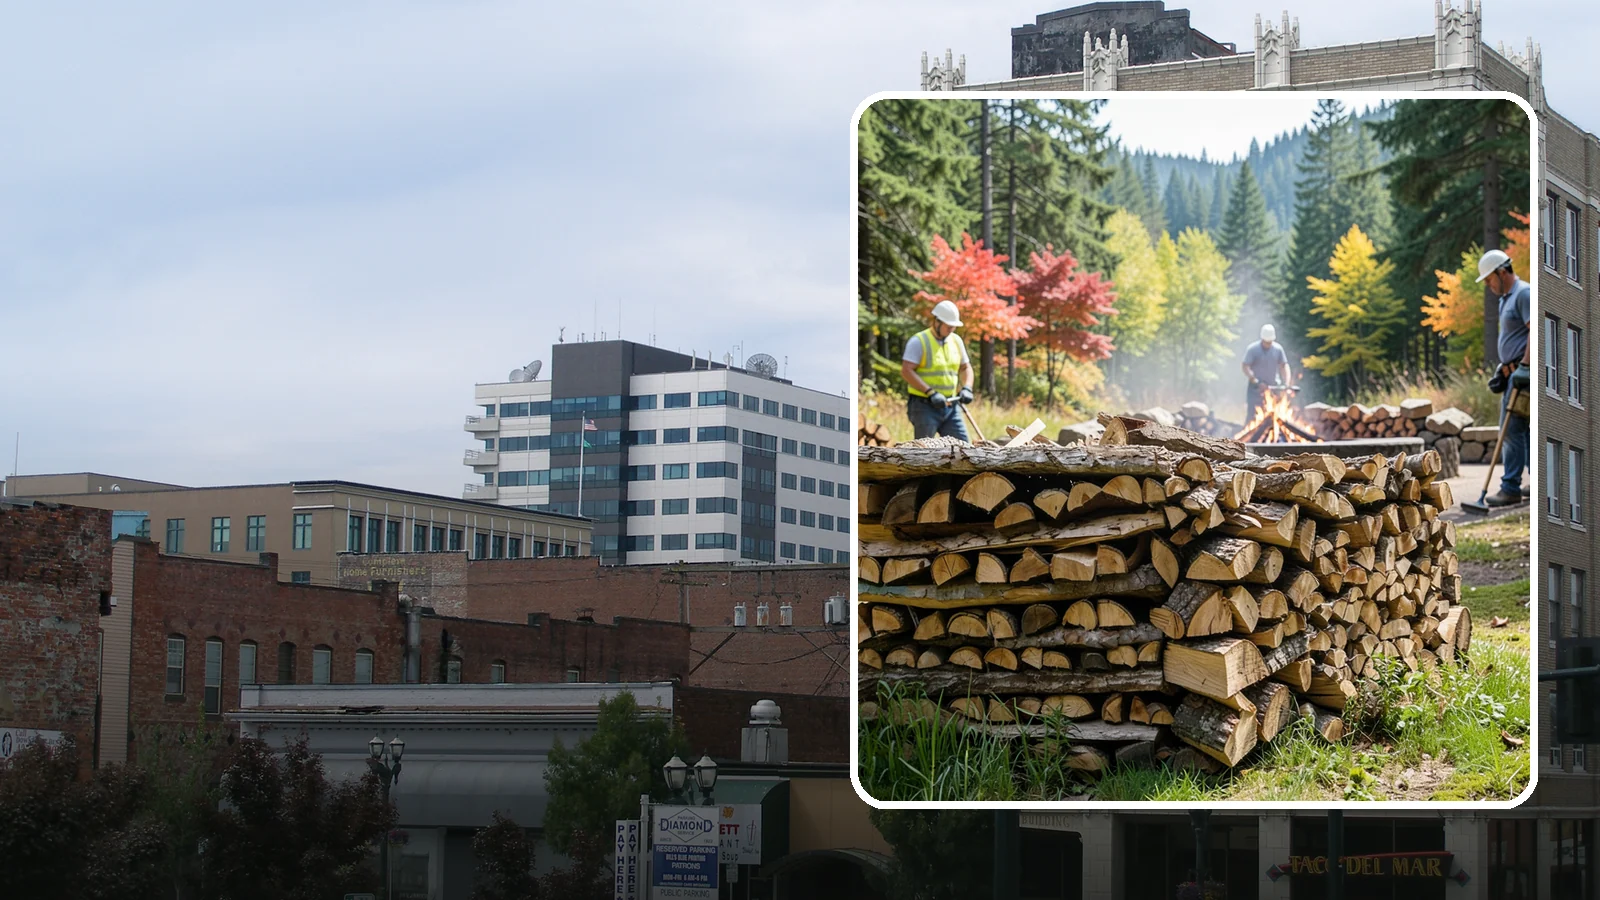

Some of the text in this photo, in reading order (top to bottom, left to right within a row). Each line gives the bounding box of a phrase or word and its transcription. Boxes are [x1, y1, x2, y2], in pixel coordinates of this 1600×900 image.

[343, 565, 427, 576] Home Furnishers
[660, 818, 713, 832] DIAMOND
[1022, 815, 1069, 828] BUILDING
[656, 845, 716, 854] RESERVED PARKING
[722, 851, 739, 861] Soup
[616, 825, 625, 893] PAY HERE
[627, 824, 637, 893] PAY HERE
[1289, 855, 1442, 877] TAC DEL MAR
[660, 888, 710, 898] PUBLIC PARKING
